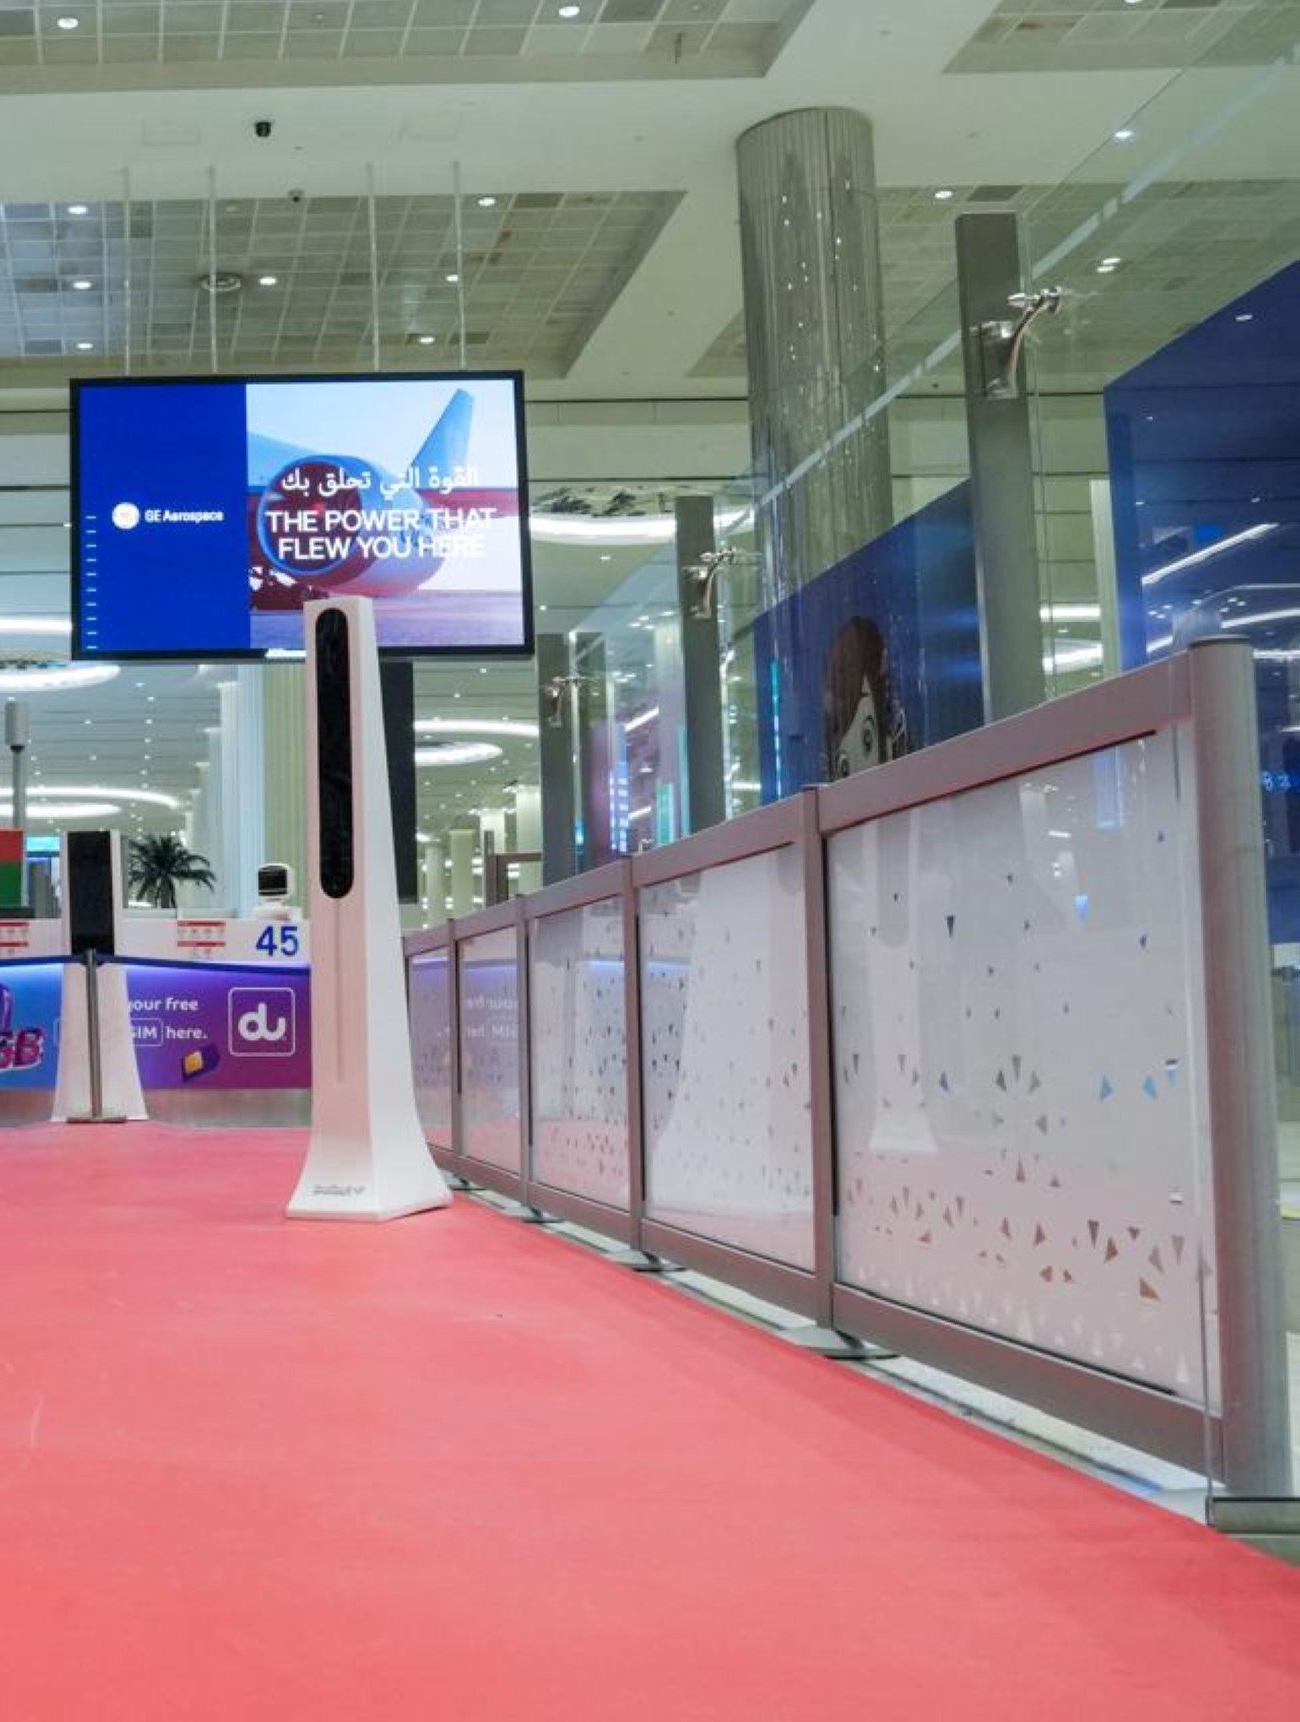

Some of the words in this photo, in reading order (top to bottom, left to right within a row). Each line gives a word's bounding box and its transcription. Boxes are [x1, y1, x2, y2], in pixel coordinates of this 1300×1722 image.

[282, 468, 310, 497] بك
[318, 467, 372, 497] تحلق
[380, 467, 420, 500] التي
[144, 509, 162, 523] GE
[163, 510, 225, 524] Aerospace
[265, 510, 318, 534] THE
[325, 509, 420, 532] POWER
[426, 508, 498, 530] THAT
[278, 537, 351, 560] FLEW
[357, 536, 410, 558] YOU
[418, 534, 488, 558] HERE
[255, 925, 300, 957] 45
[165, 997, 199, 1011] free
[166, 1025, 209, 1040] here.
[237, 1003, 287, 1042] du
